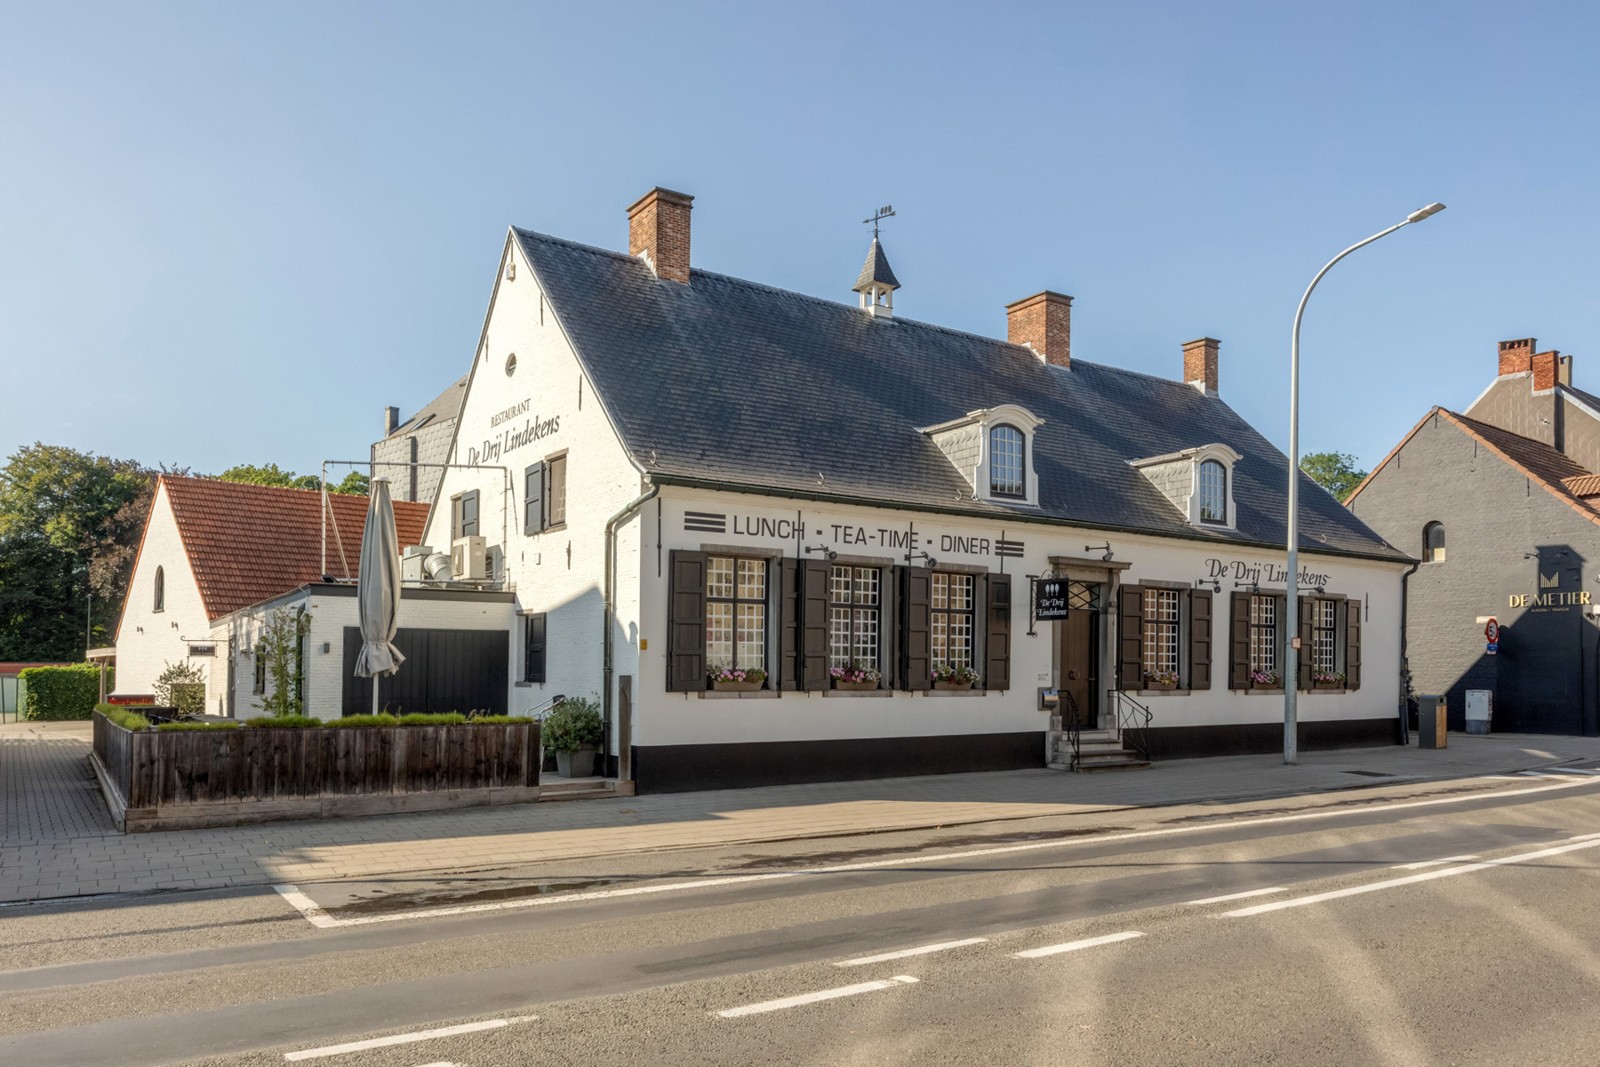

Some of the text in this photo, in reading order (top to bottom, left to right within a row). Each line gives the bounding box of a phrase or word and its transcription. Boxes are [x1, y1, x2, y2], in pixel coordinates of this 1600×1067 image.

[491, 398, 531, 428] RESTAURANT
[467, 415, 560, 469] De Drij Lindekens
[733, 515, 990, 555] LUNCH TEA-TIME DINER
[1205, 558, 1331, 586] De Drij Linekens
[1040, 599, 1050, 607] De
[1509, 592, 1591, 608] DE METIER
